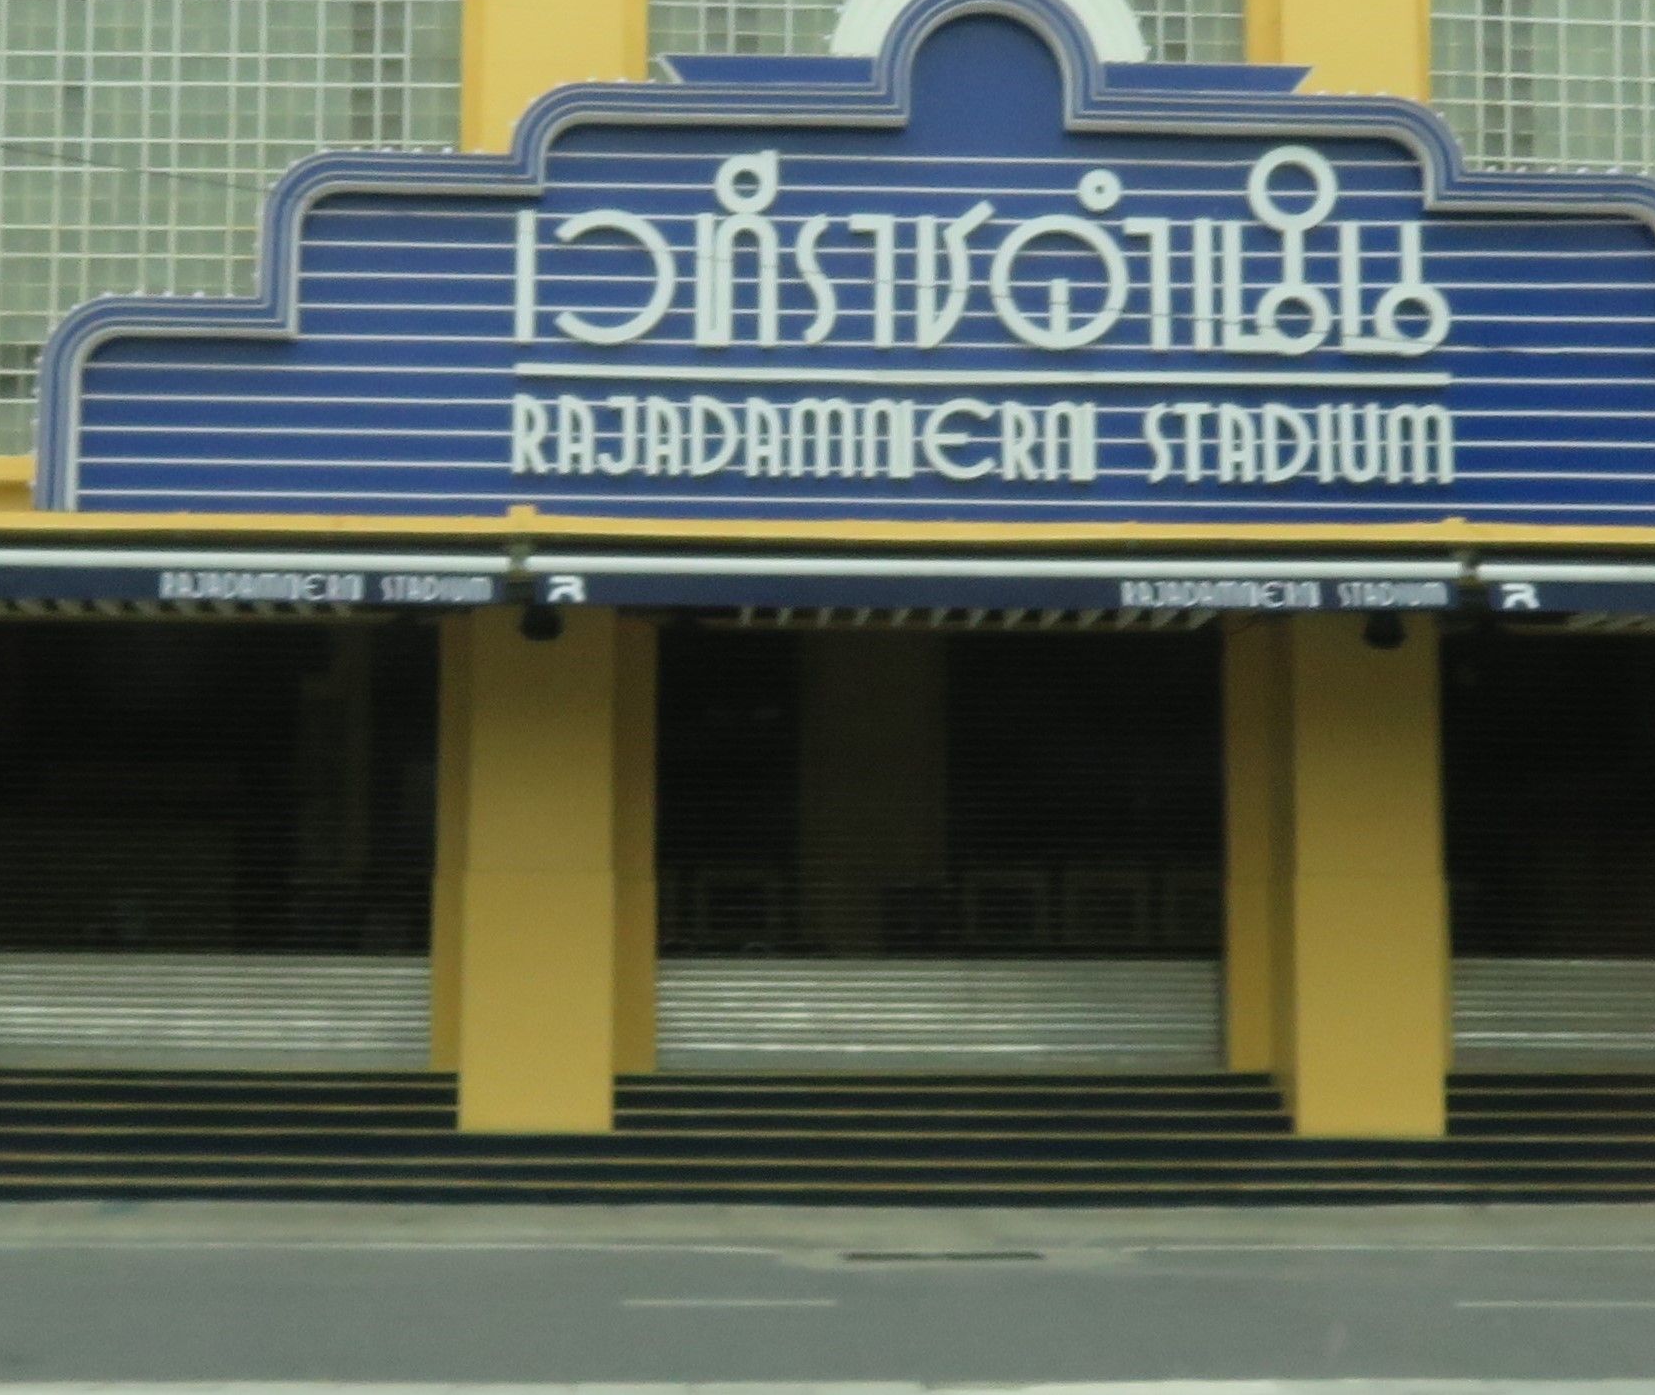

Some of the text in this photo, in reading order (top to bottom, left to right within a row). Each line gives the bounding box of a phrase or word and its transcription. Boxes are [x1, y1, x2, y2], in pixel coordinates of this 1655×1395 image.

[514, 145, 1450, 356] เวทีราชดำเนิน
[511, 393, 1454, 484] RAJADAMNERN STADIUM
